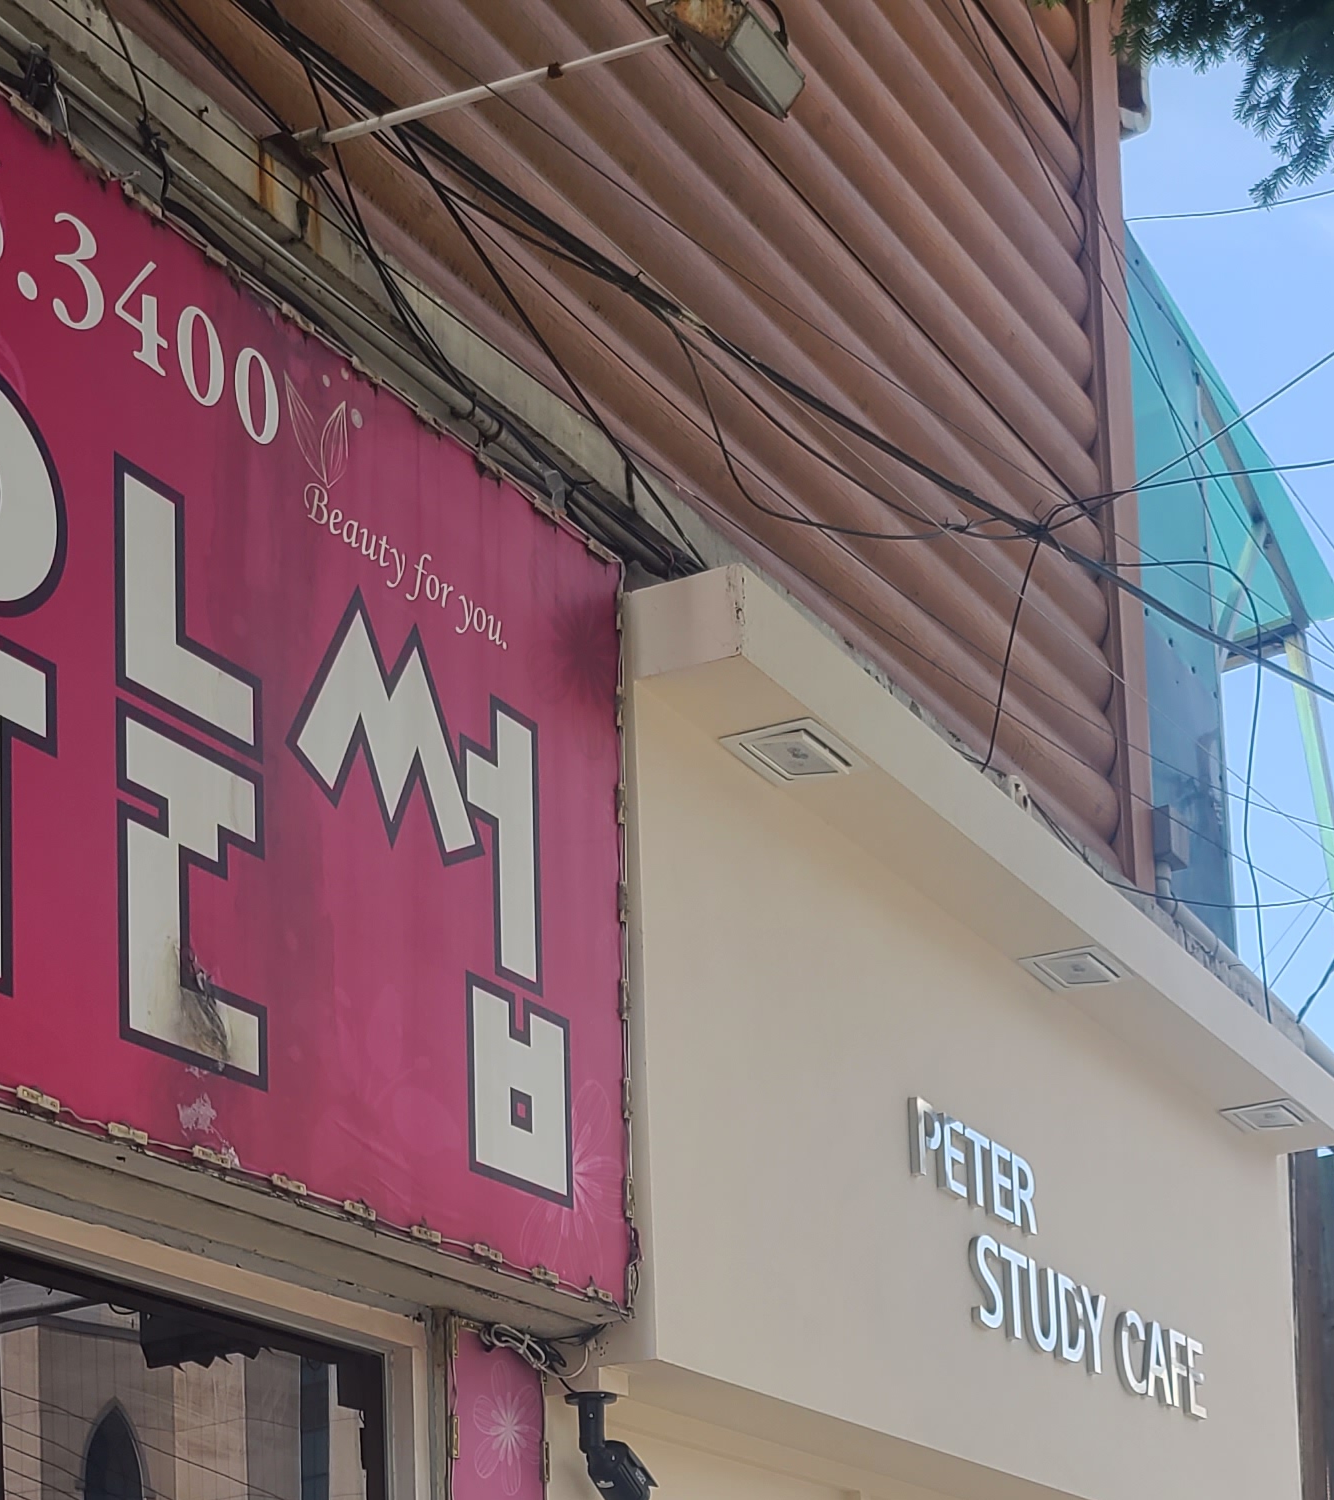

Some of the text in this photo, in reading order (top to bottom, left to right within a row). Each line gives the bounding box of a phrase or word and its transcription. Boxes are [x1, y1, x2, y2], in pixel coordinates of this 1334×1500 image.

[304, 483, 508, 650] Beauty for you.
[907, 1096, 1038, 1236] PETER
[968, 1234, 1208, 1420] STUDY CAFE
